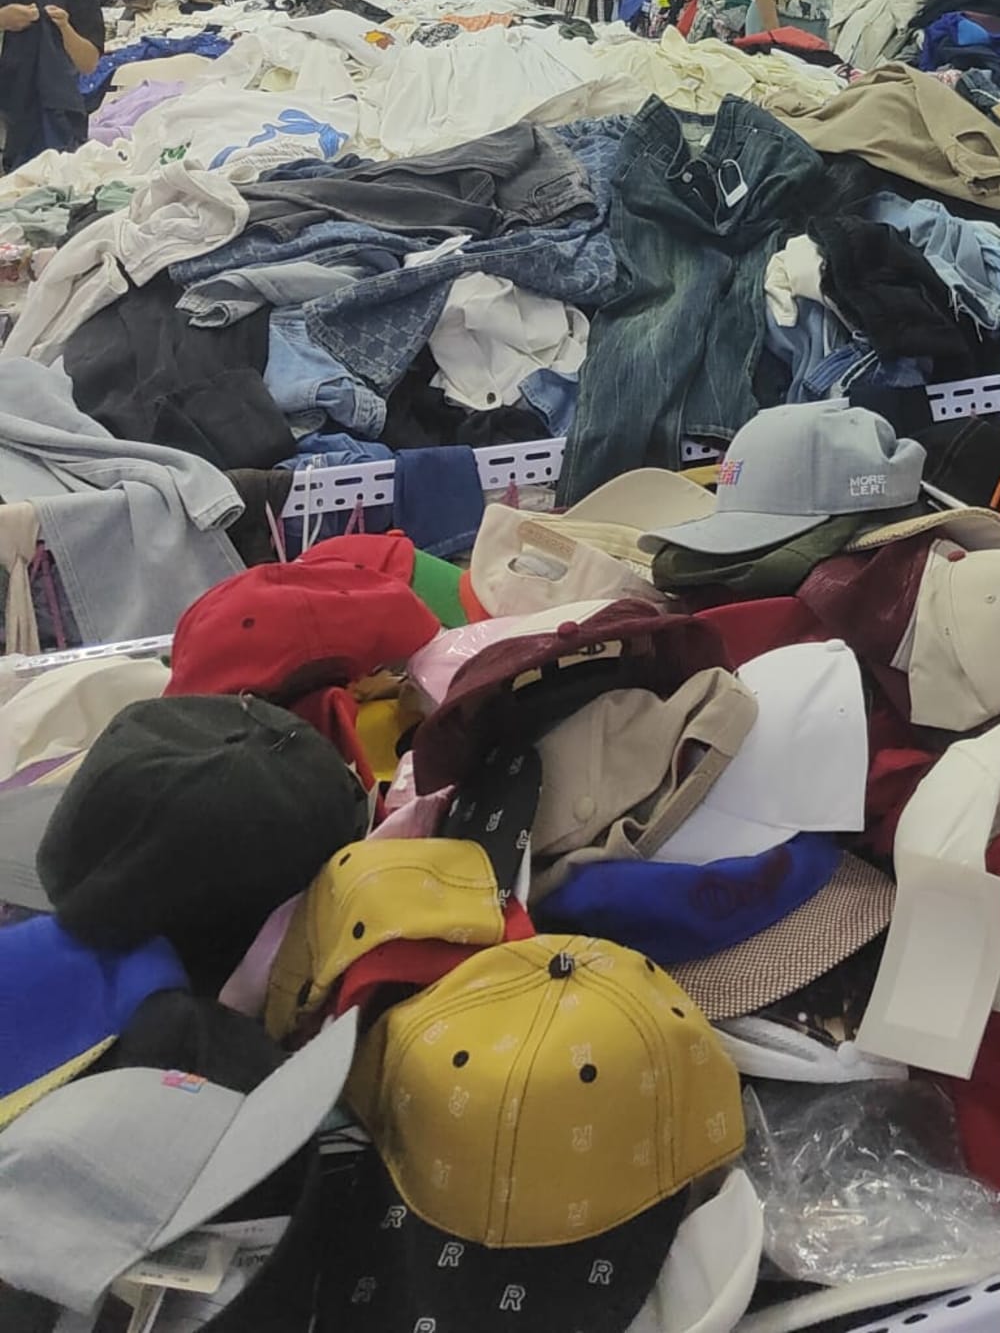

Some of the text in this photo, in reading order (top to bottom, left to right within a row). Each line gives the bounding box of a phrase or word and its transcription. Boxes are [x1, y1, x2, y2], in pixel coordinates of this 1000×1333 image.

[850, 474, 887, 487] MORE
[437, 1242, 464, 1267] R
[587, 1259, 613, 1285] R
[500, 1284, 526, 1311] R
